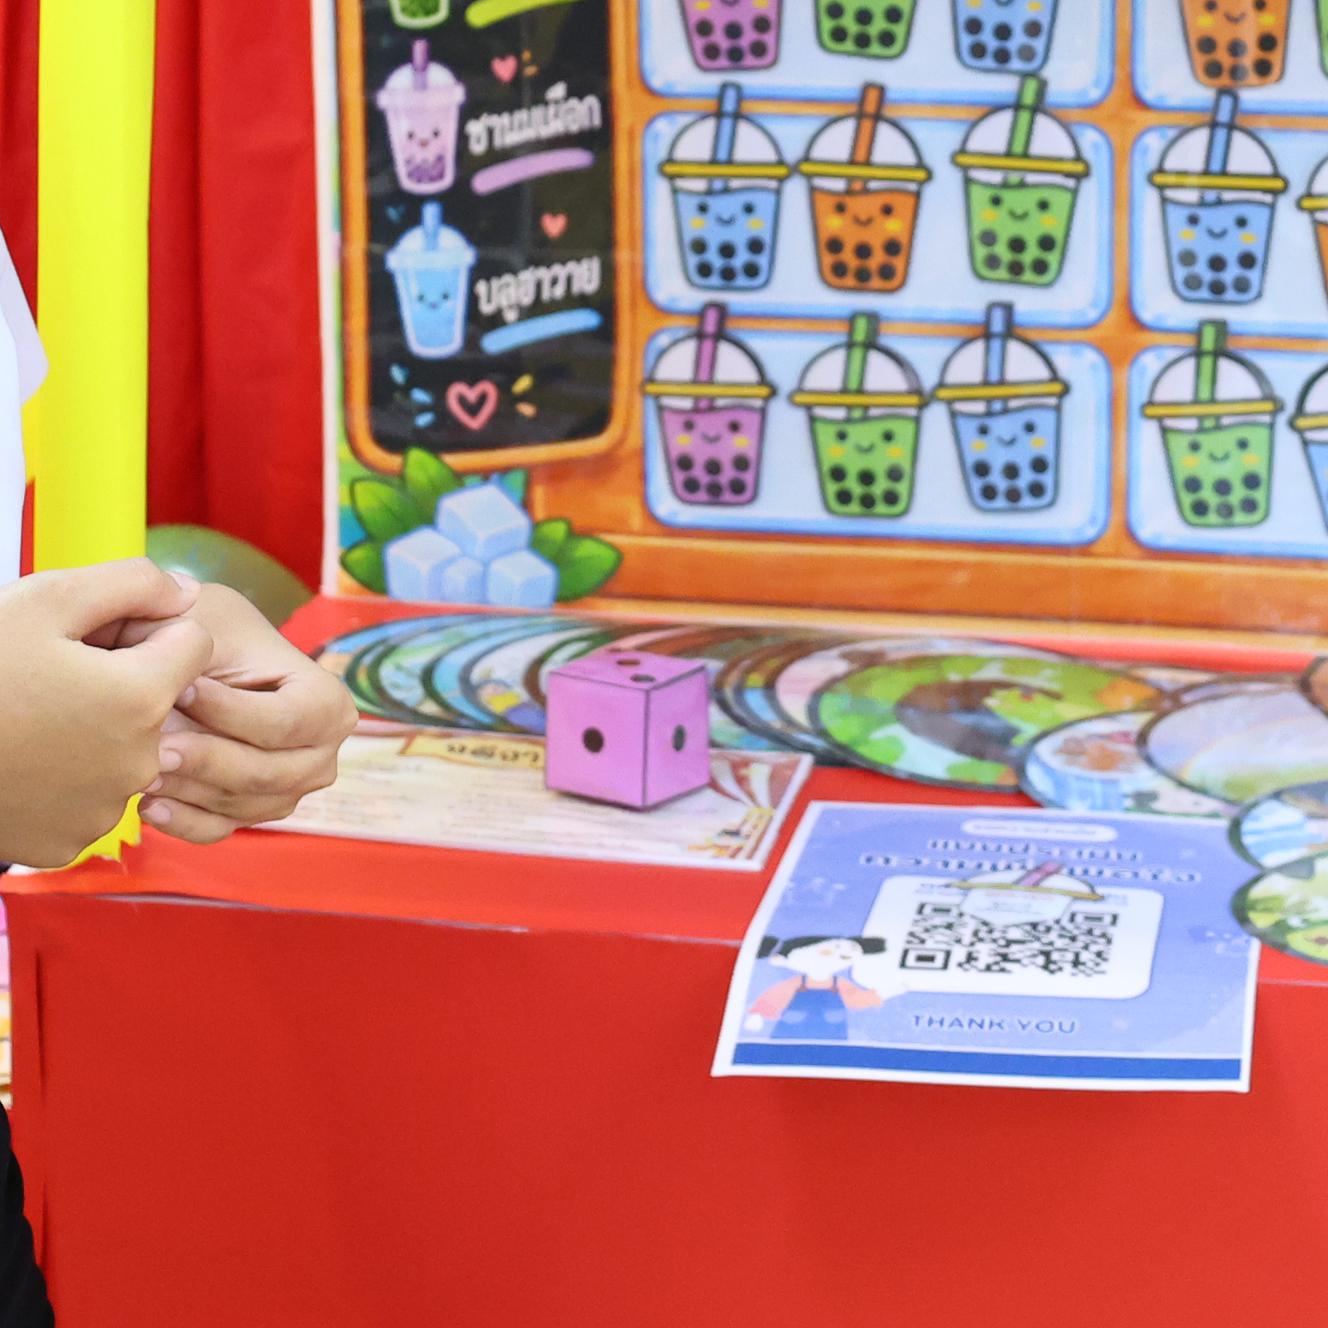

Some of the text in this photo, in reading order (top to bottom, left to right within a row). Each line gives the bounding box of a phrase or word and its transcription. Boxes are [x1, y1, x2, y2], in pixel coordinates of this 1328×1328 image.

[464, 80, 602, 156] ชานมเผือก
[474, 255, 601, 324] บลูฮาวาย
[913, 1015, 1076, 1034] THANK YOU
